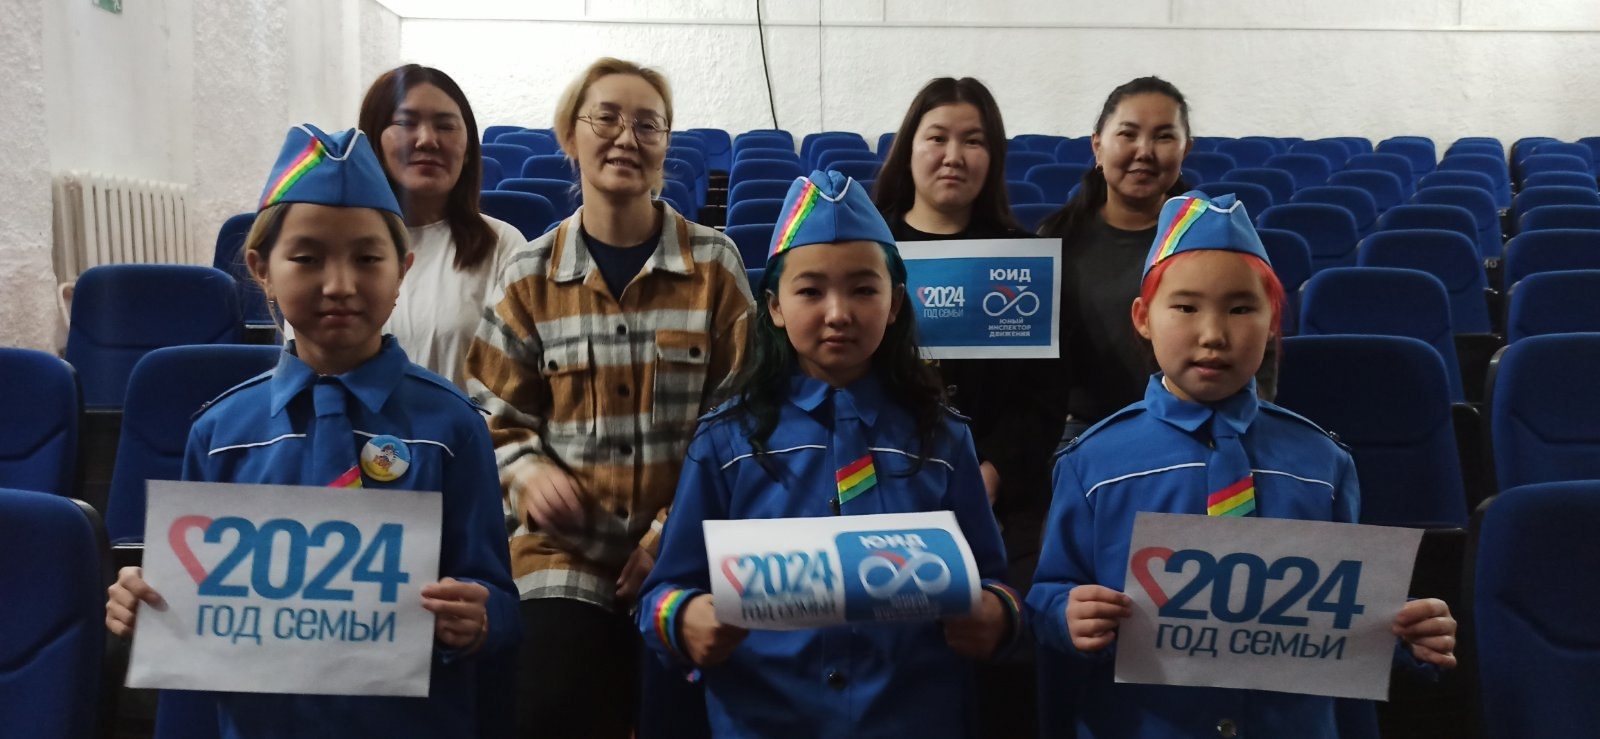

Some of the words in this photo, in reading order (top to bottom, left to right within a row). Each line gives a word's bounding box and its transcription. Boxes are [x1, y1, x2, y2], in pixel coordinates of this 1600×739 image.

[924, 286, 966, 307] 2024
[990, 268, 1031, 282] ЮИД
[197, 516, 410, 603] 2024
[738, 549, 838, 598] 2024
[1158, 548, 1366, 630] 2024
